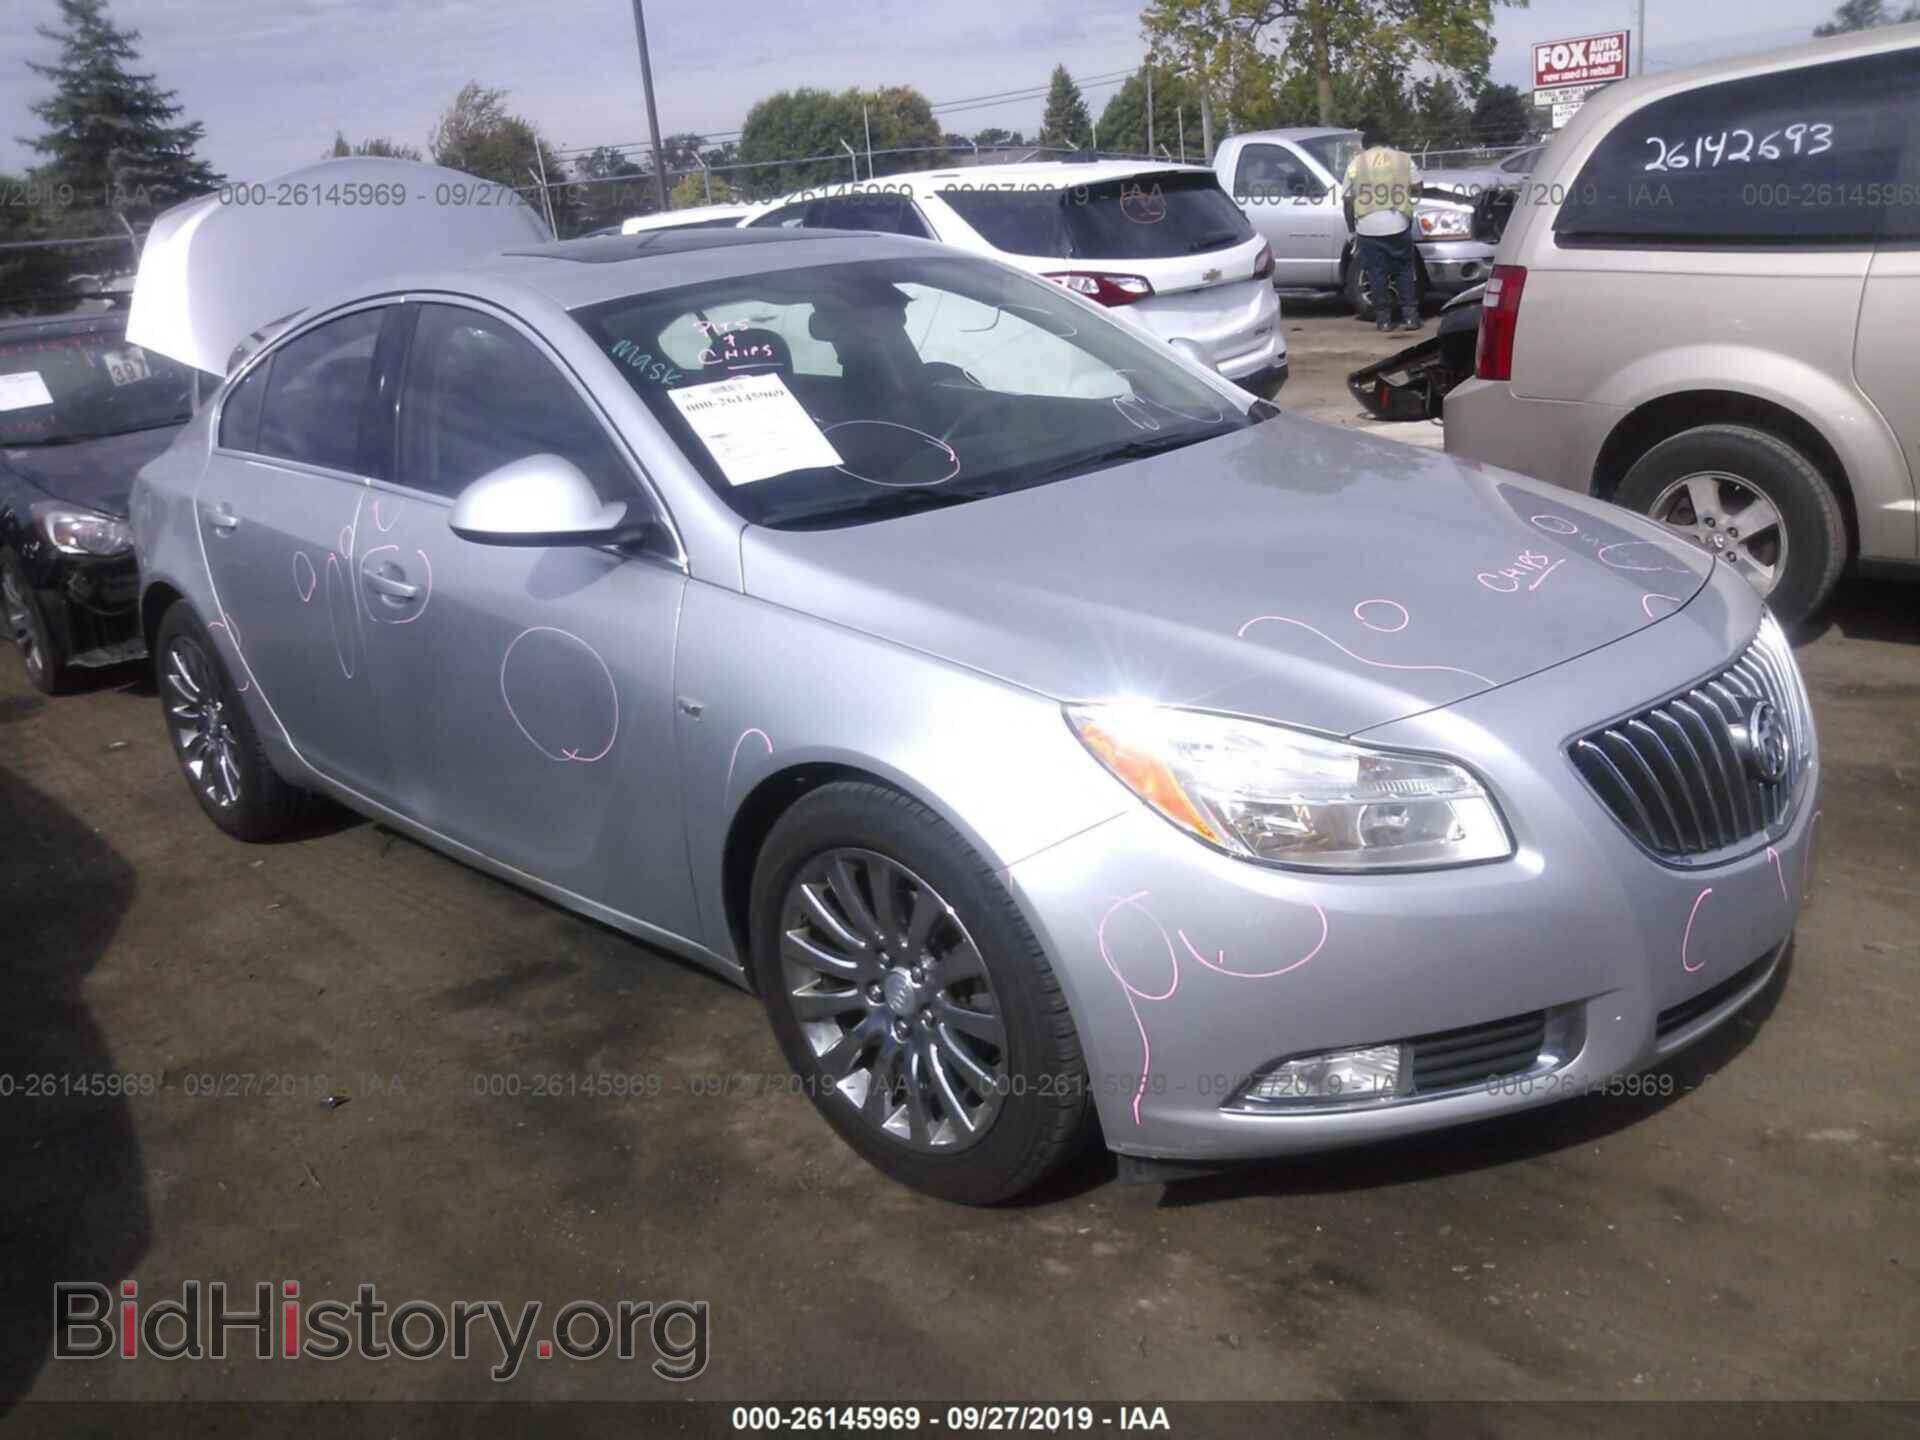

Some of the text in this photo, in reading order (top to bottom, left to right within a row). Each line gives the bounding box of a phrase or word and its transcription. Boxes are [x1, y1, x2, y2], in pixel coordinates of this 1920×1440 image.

[1537, 41, 1588, 72] FOX
[1589, 37, 1619, 53] AUTO
[1589, 49, 1622, 65] PARTS
[1645, 123, 1833, 171] 26142693
[697, 344, 774, 365] CHIPS
[1477, 549, 1548, 592] CHIPS
